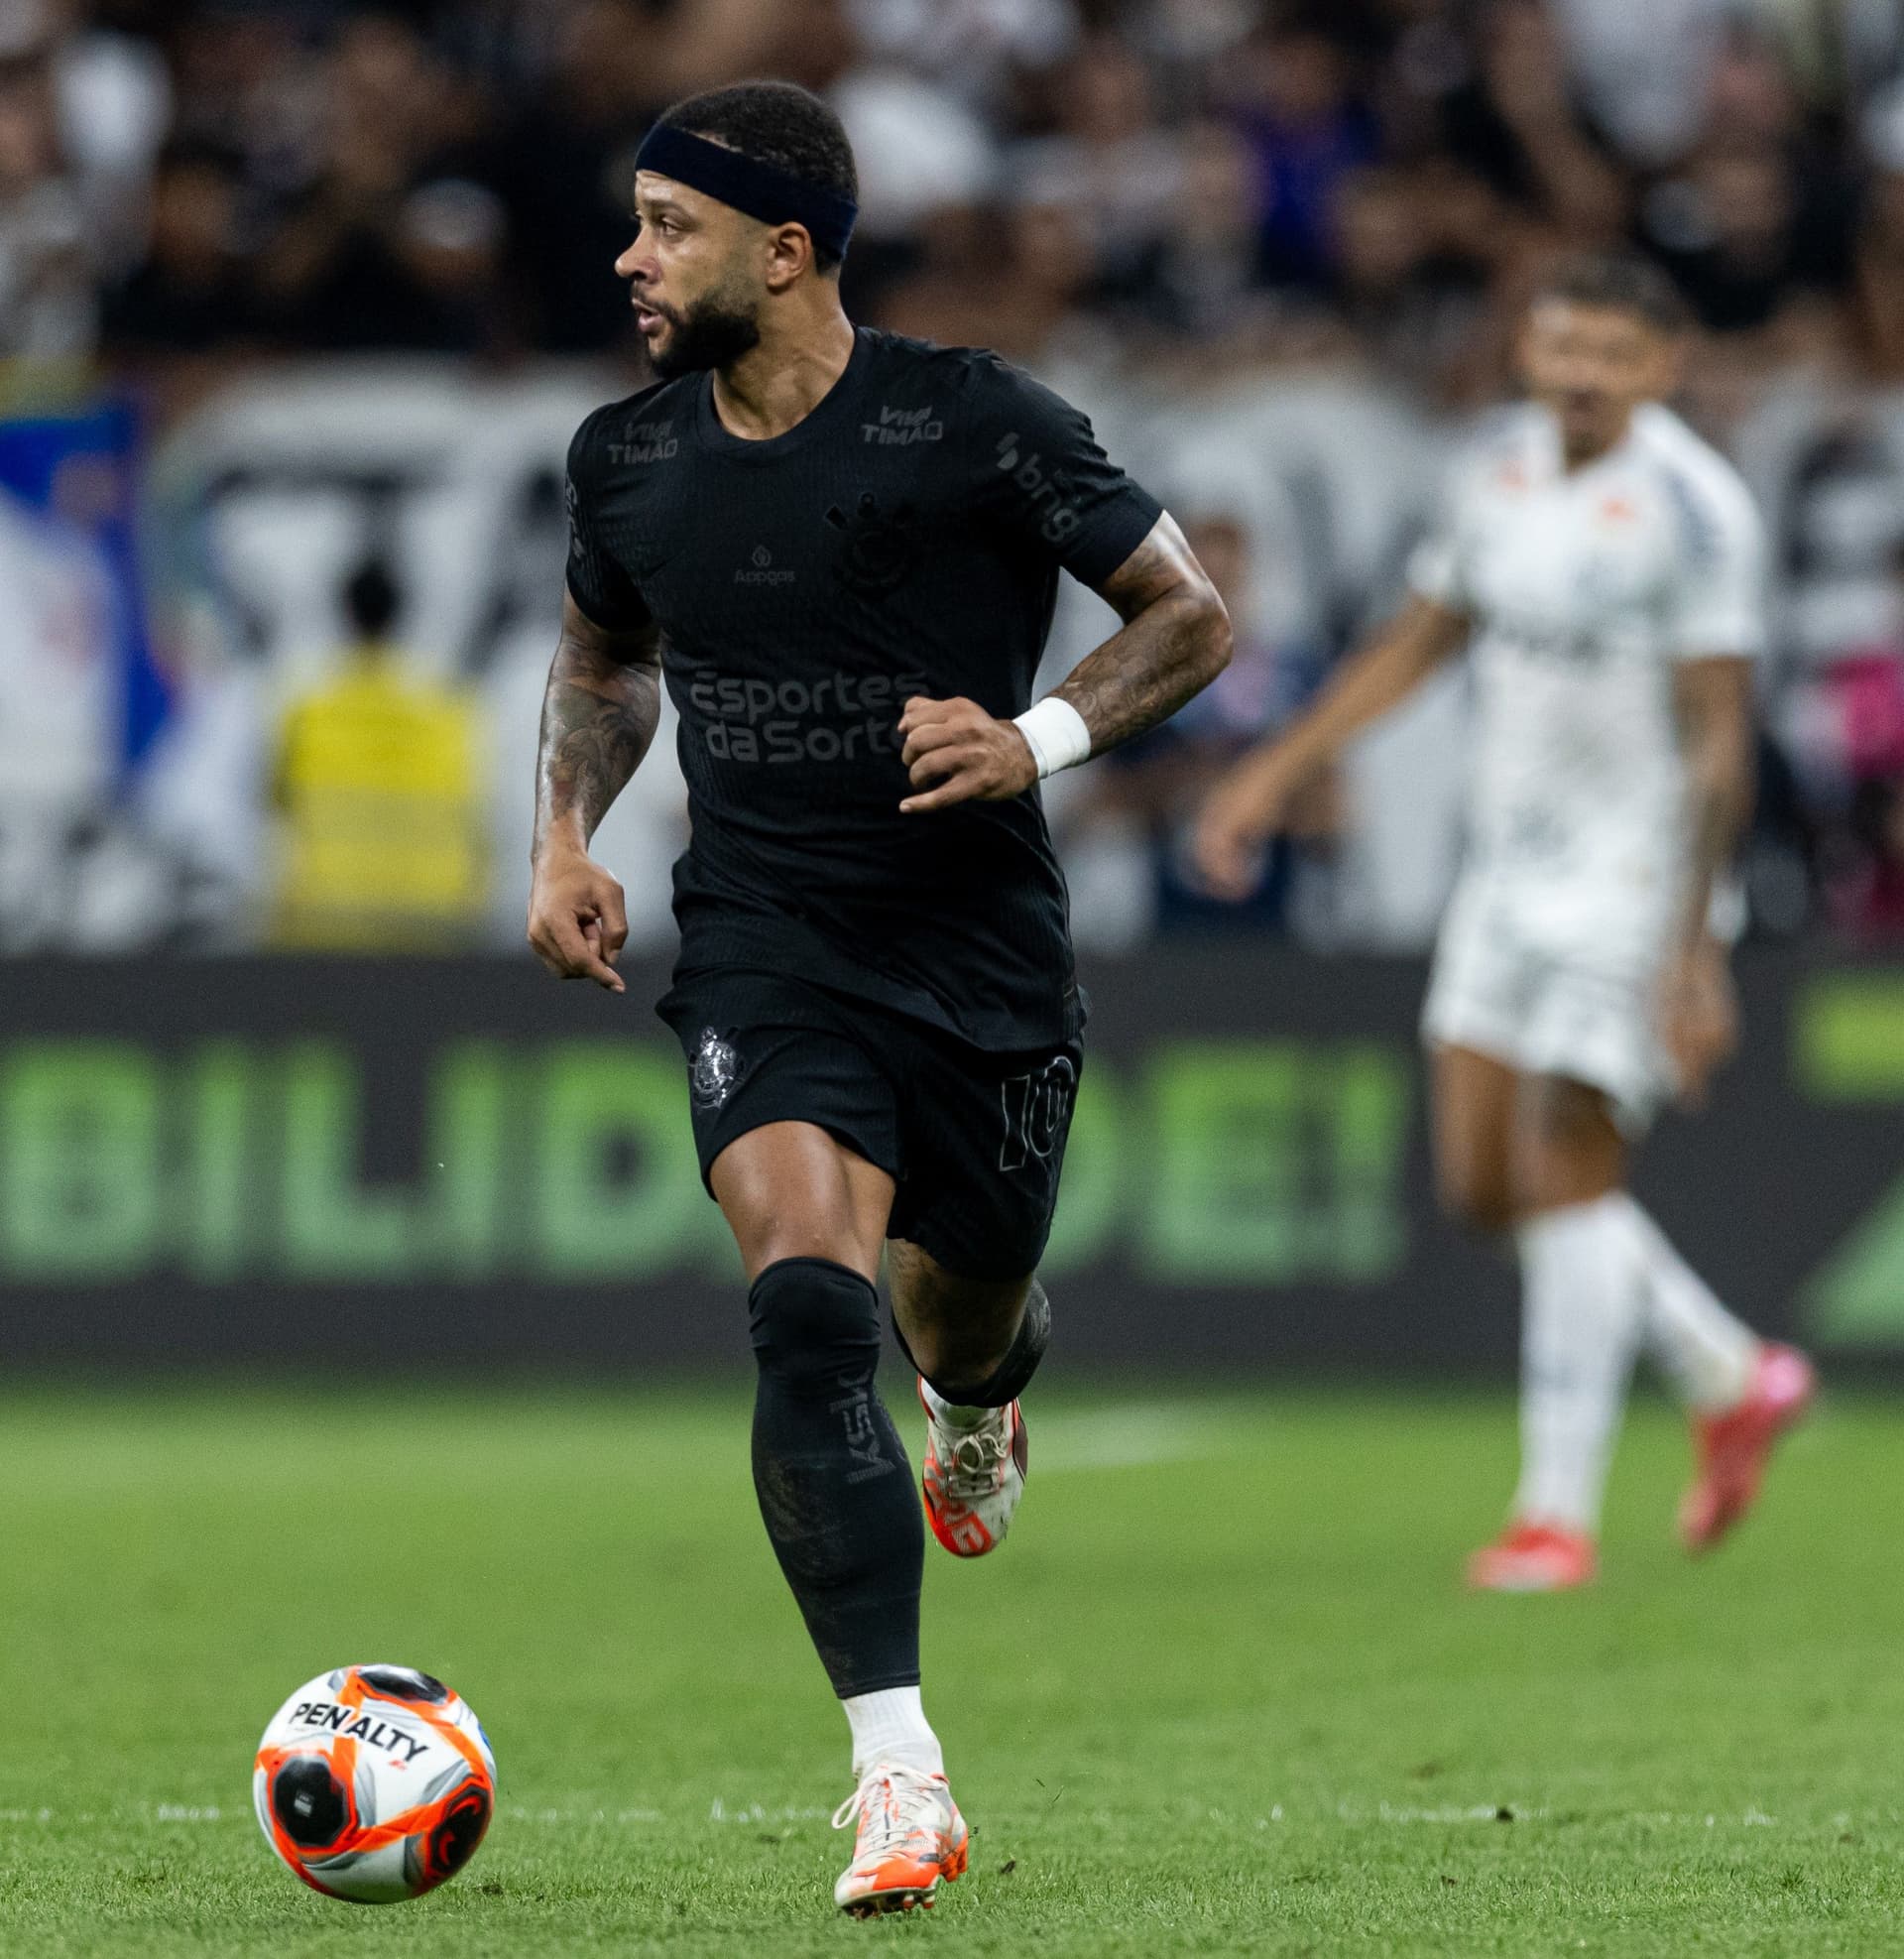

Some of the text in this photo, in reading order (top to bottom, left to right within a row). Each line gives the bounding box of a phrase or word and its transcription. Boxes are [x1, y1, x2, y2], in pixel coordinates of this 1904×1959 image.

[705, 716, 903, 763] daSort
[999, 1054, 1078, 1172] 10
[289, 1702, 430, 1763] PENALTY
